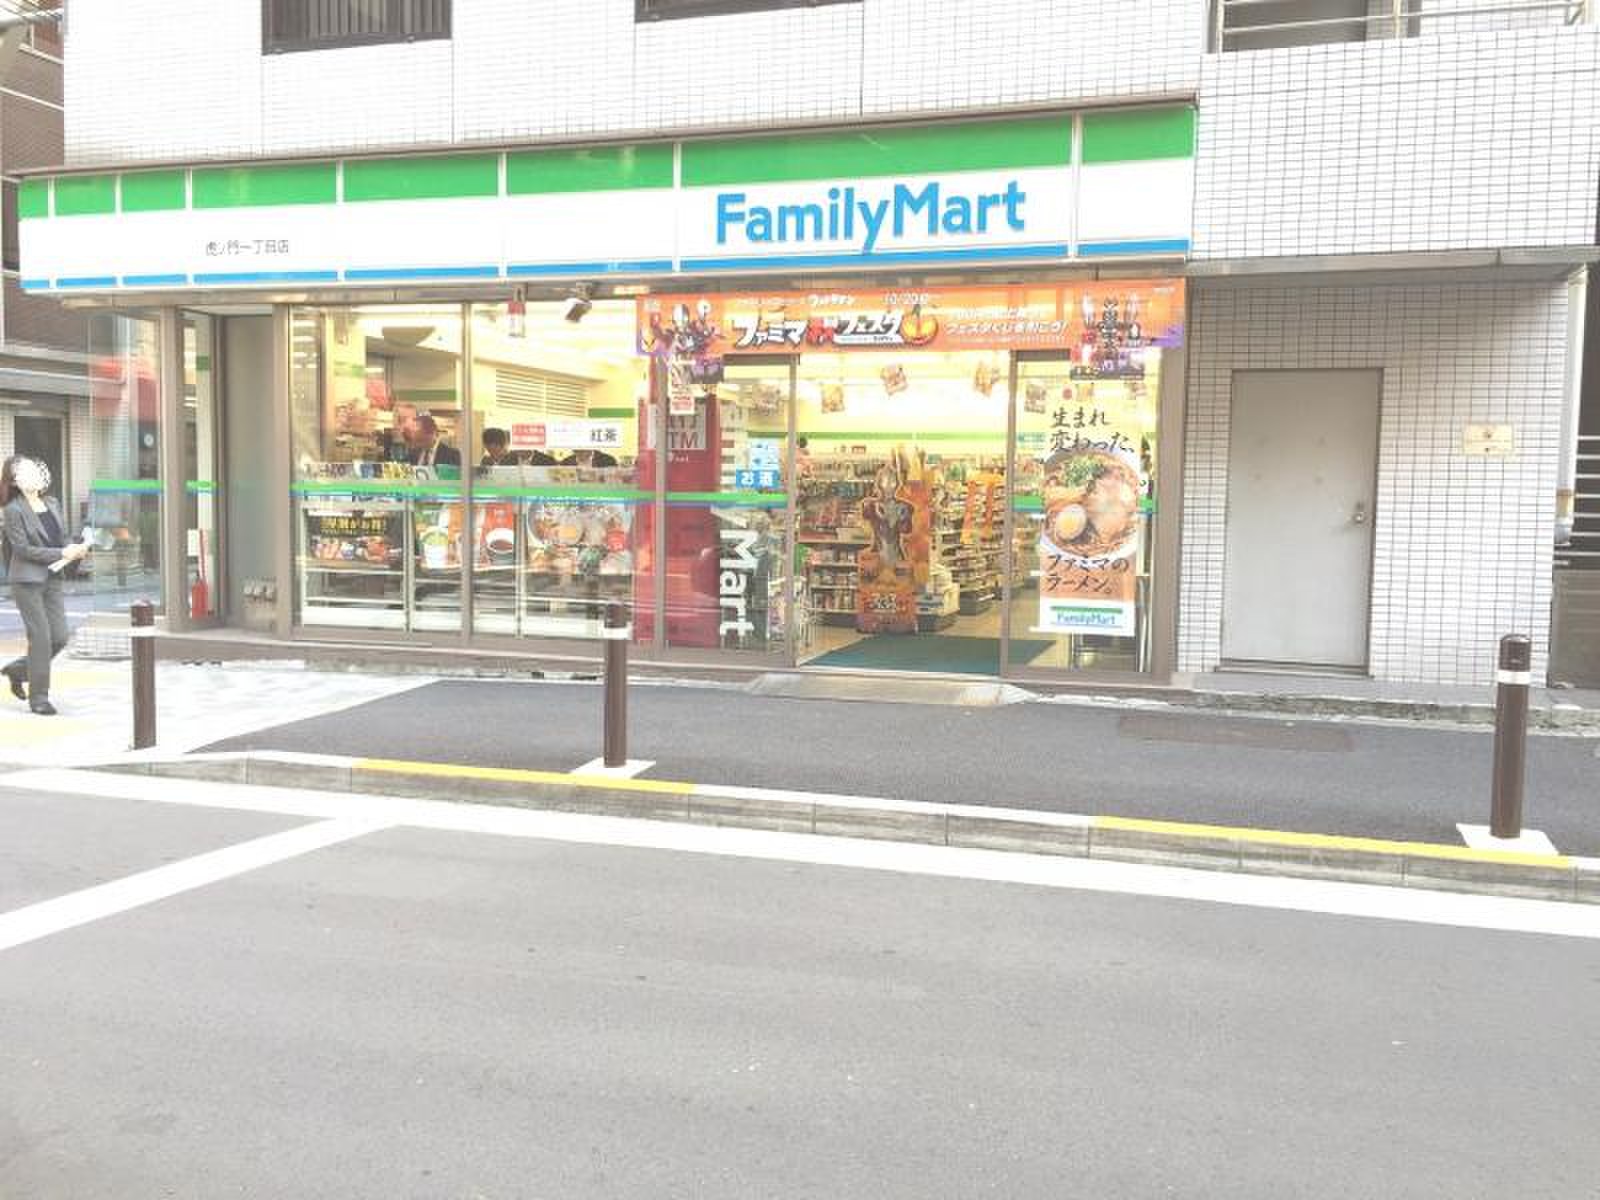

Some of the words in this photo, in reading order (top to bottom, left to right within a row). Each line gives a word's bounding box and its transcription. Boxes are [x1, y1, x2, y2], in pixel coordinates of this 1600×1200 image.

[716, 181, 1026, 255] FamilyMart
[1049, 406, 1113, 428] 生まれ
[1047, 554, 1130, 572] ファミマの
